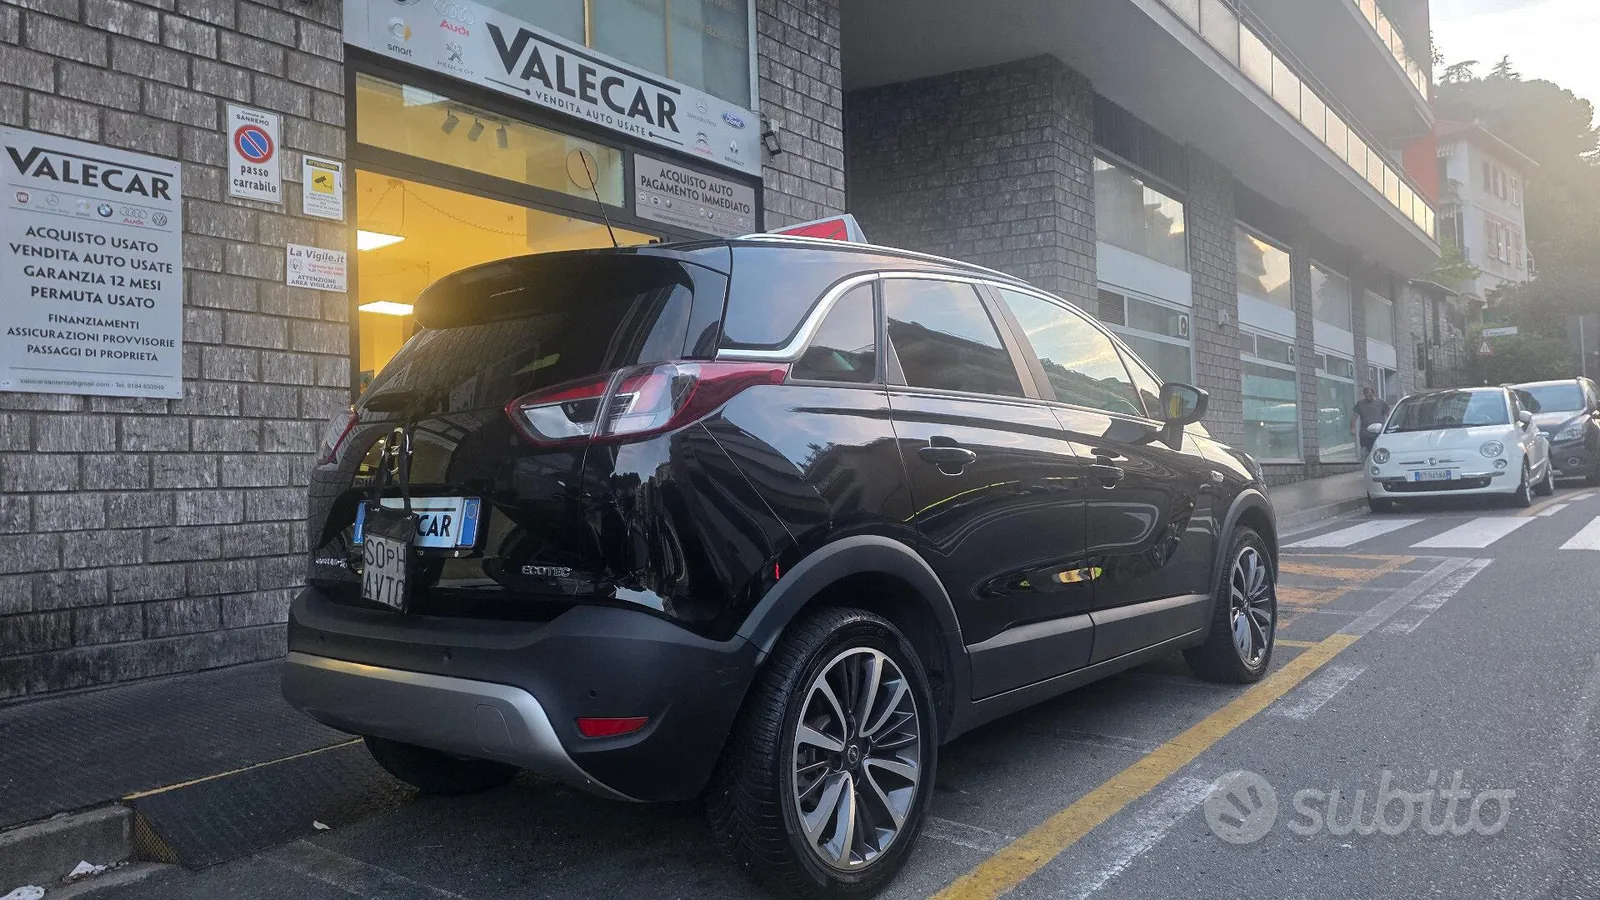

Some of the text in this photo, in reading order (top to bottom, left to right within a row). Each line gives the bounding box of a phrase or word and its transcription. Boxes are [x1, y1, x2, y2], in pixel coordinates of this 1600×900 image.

[440, 19, 470, 37] Audi
[387, 42, 413, 57] smart
[485, 21, 681, 134] VALECAR
[236, 114, 270, 126] SANREMO
[535, 90, 647, 136] VENDITA AUTO USATE
[5, 146, 173, 201] VALECAR
[240, 165, 269, 178] passo
[233, 178, 277, 193] carrabile
[660, 168, 733, 197] ACQUISTO AUTO
[641, 175, 750, 214] PAGAMENTO IMMEDIATO
[26, 226, 159, 253] ACQUISTO USATO
[9, 243, 173, 274] VENDITA AUTO USATE
[289, 247, 344, 263] La Vigile.it
[24, 265, 161, 291] GARANZIA 12 MESI
[297, 274, 336, 285] ATTENZIONE
[31, 286, 155, 309] PERMUTA USATO
[48, 314, 139, 330] FINANZIAMENTI
[7, 327, 175, 348] ASSICURAZIONI PROVVISORIE
[27, 344, 81, 357] PASSAGGI
[85, 348, 97, 358] DI
[522, 565, 570, 577] ECOTEC
